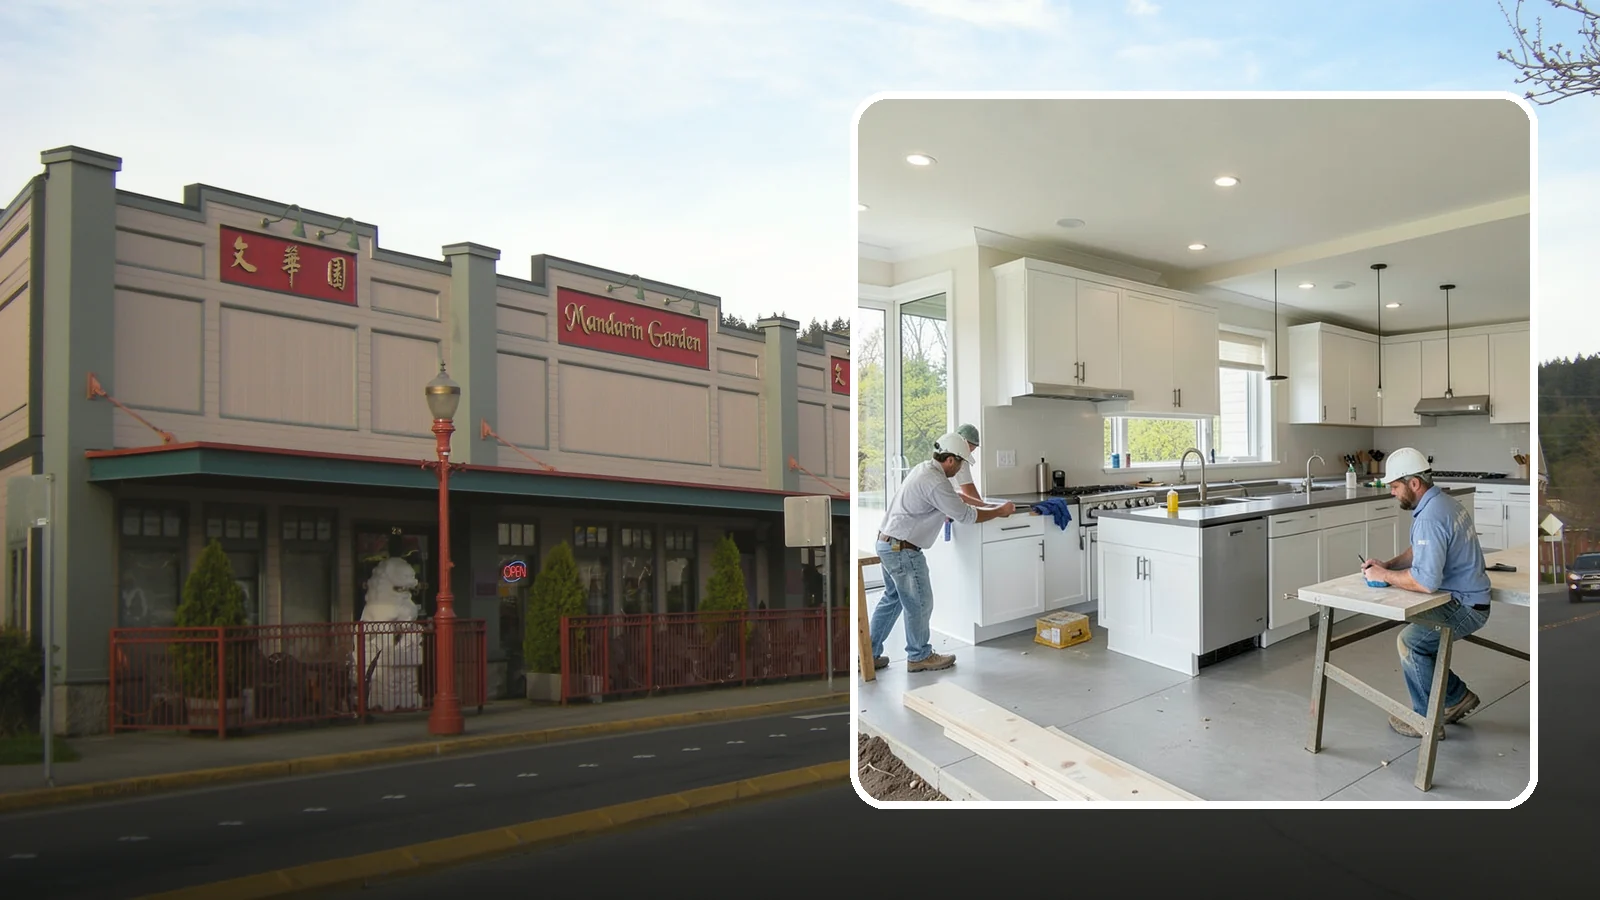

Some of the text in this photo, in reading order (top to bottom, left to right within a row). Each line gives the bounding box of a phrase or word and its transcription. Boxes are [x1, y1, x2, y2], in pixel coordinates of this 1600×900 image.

[231, 235, 346, 291] 文華園
[564, 302, 702, 352] Mandarin Garden
[503, 565, 527, 578] OPEN
